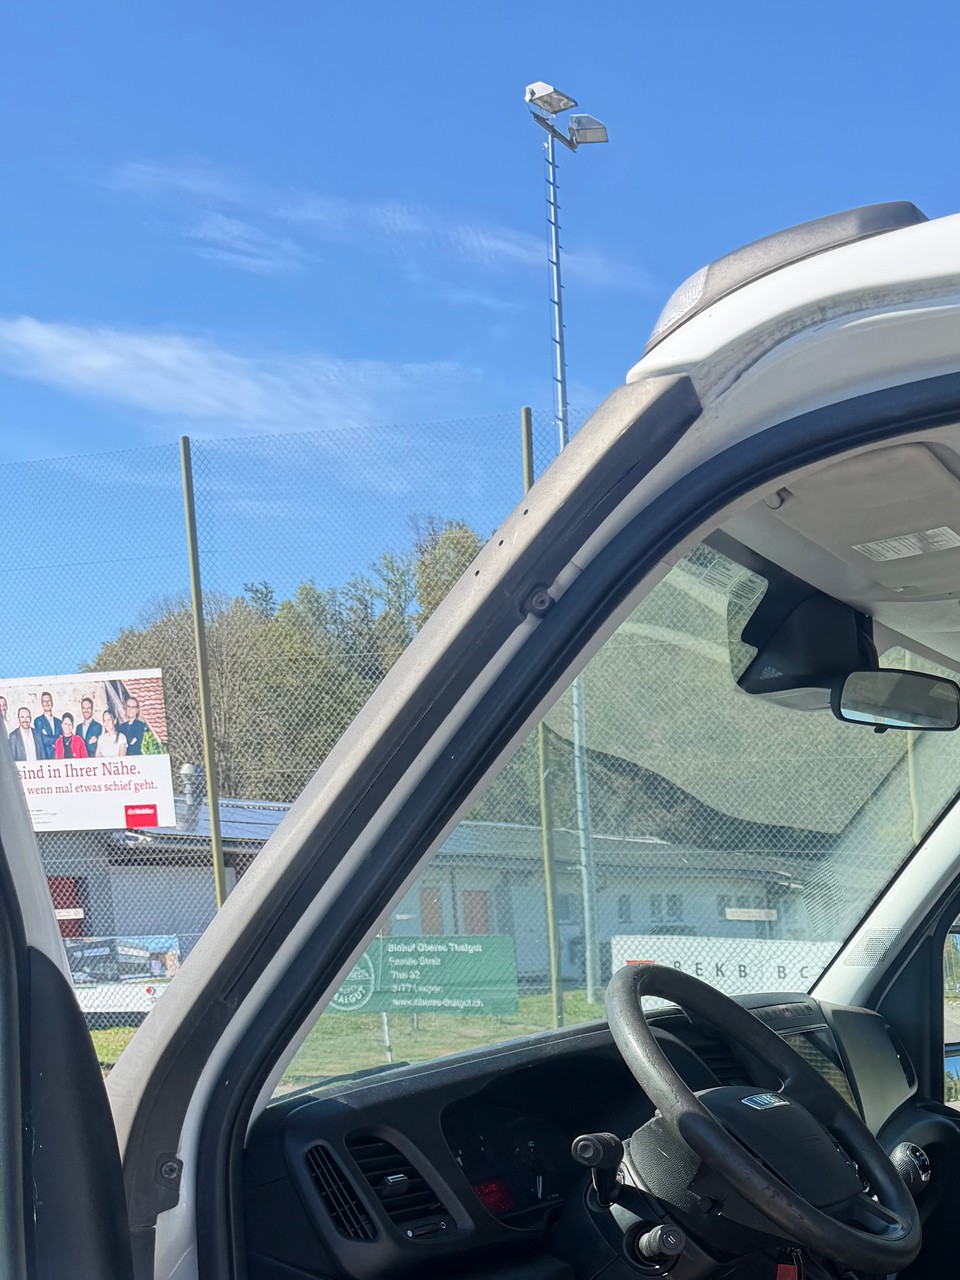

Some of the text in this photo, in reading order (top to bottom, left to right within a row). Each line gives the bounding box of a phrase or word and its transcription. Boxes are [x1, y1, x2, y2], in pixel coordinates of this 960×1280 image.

[19, 760, 141, 781] sind in Ihrer Nähe.
[27, 779, 158, 796] wenn mal etwas schief geht.
